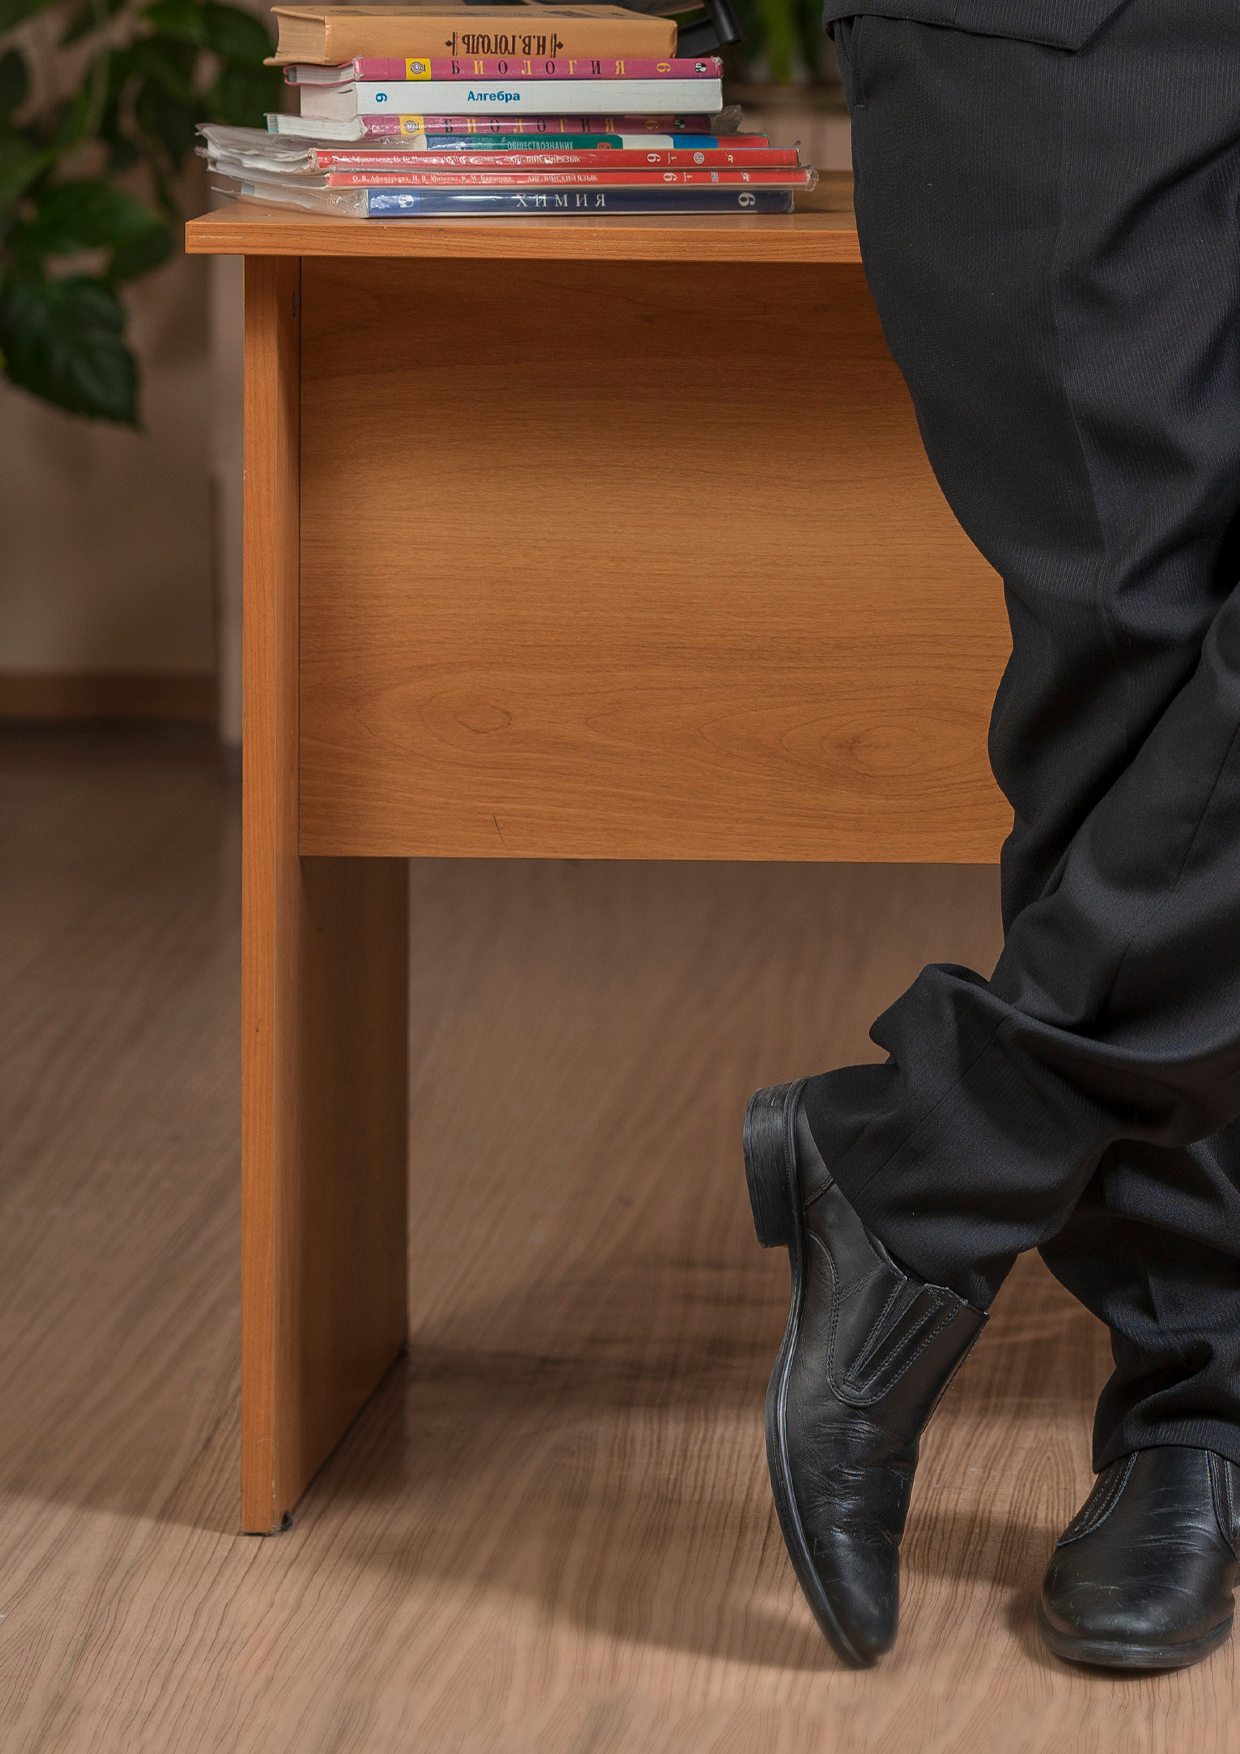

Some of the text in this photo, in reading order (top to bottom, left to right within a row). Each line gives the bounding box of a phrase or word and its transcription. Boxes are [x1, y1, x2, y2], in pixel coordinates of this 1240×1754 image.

[451, 59, 626, 75] БИОЛОГИЯ
[467, 90, 521, 103] Алгебра
[444, 117, 615, 134] БИОЛОГИЯ
[516, 193, 606, 207] ХИМИЯ
